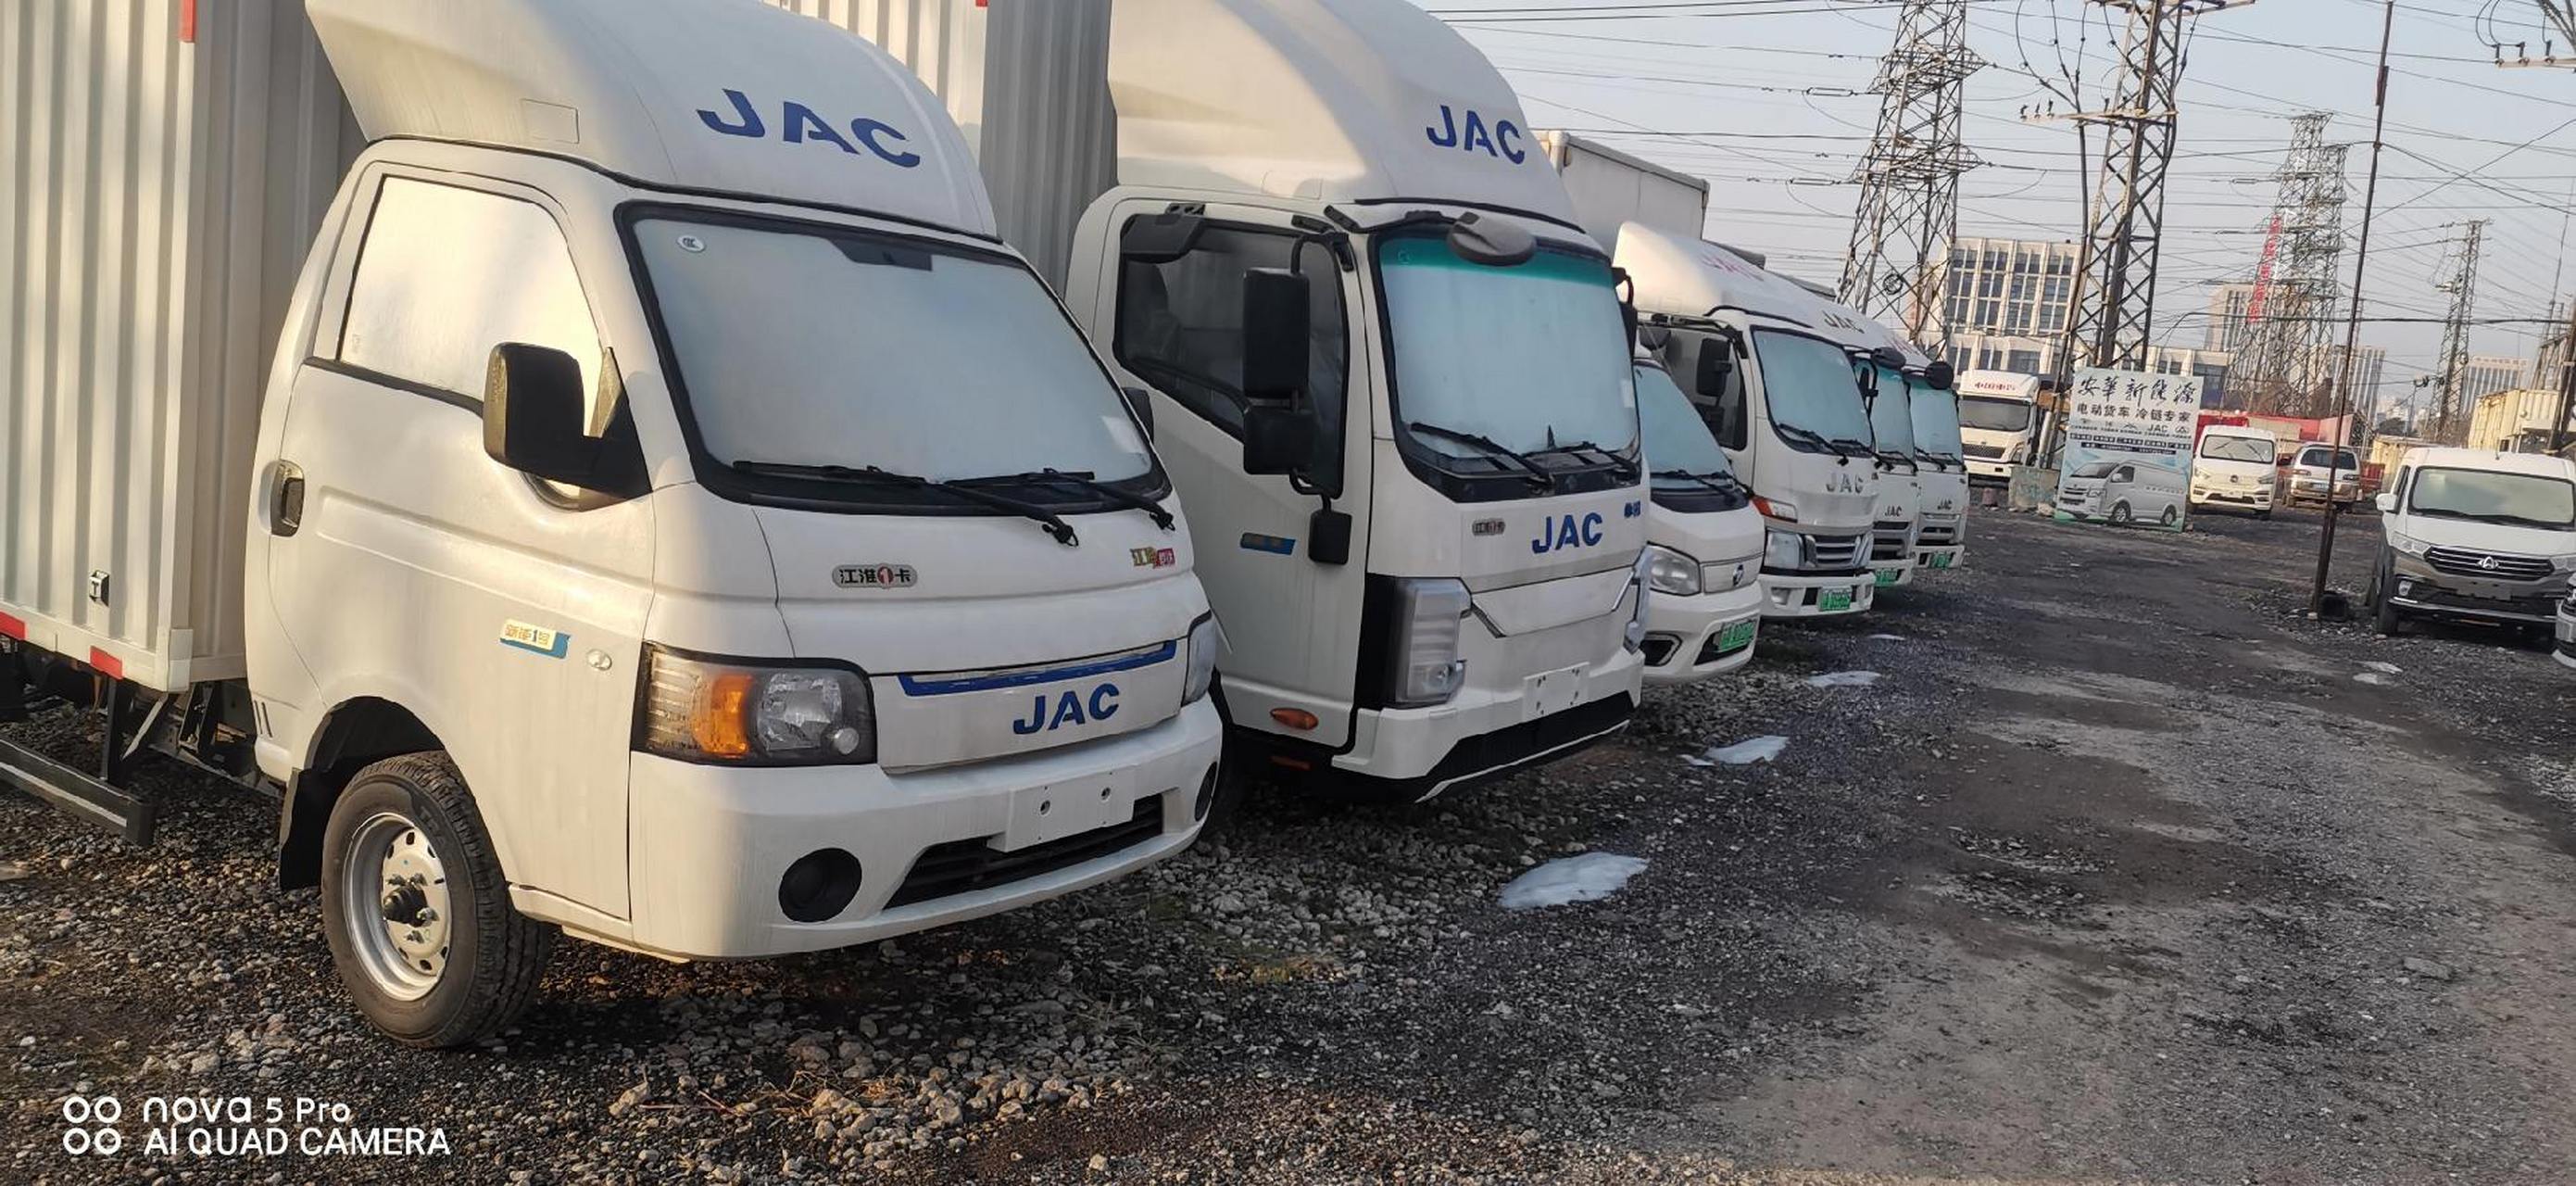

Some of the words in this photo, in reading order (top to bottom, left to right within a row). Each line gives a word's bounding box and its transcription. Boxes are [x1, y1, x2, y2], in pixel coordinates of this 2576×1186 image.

[697, 89, 921, 168] JAC
[1426, 105, 1525, 165] JAC
[2077, 403, 2130, 418] 电动货车
[2135, 409, 2192, 423] 冷链专家
[2147, 423, 2169, 434] JAC
[1826, 473, 1864, 494] JAC
[1884, 505, 1903, 517] JAC
[1938, 499, 1953, 511] JAC
[1531, 511, 1603, 554] JAC
[838, 566, 911, 587] 江淮1卡
[1012, 683, 1119, 735] JAC
